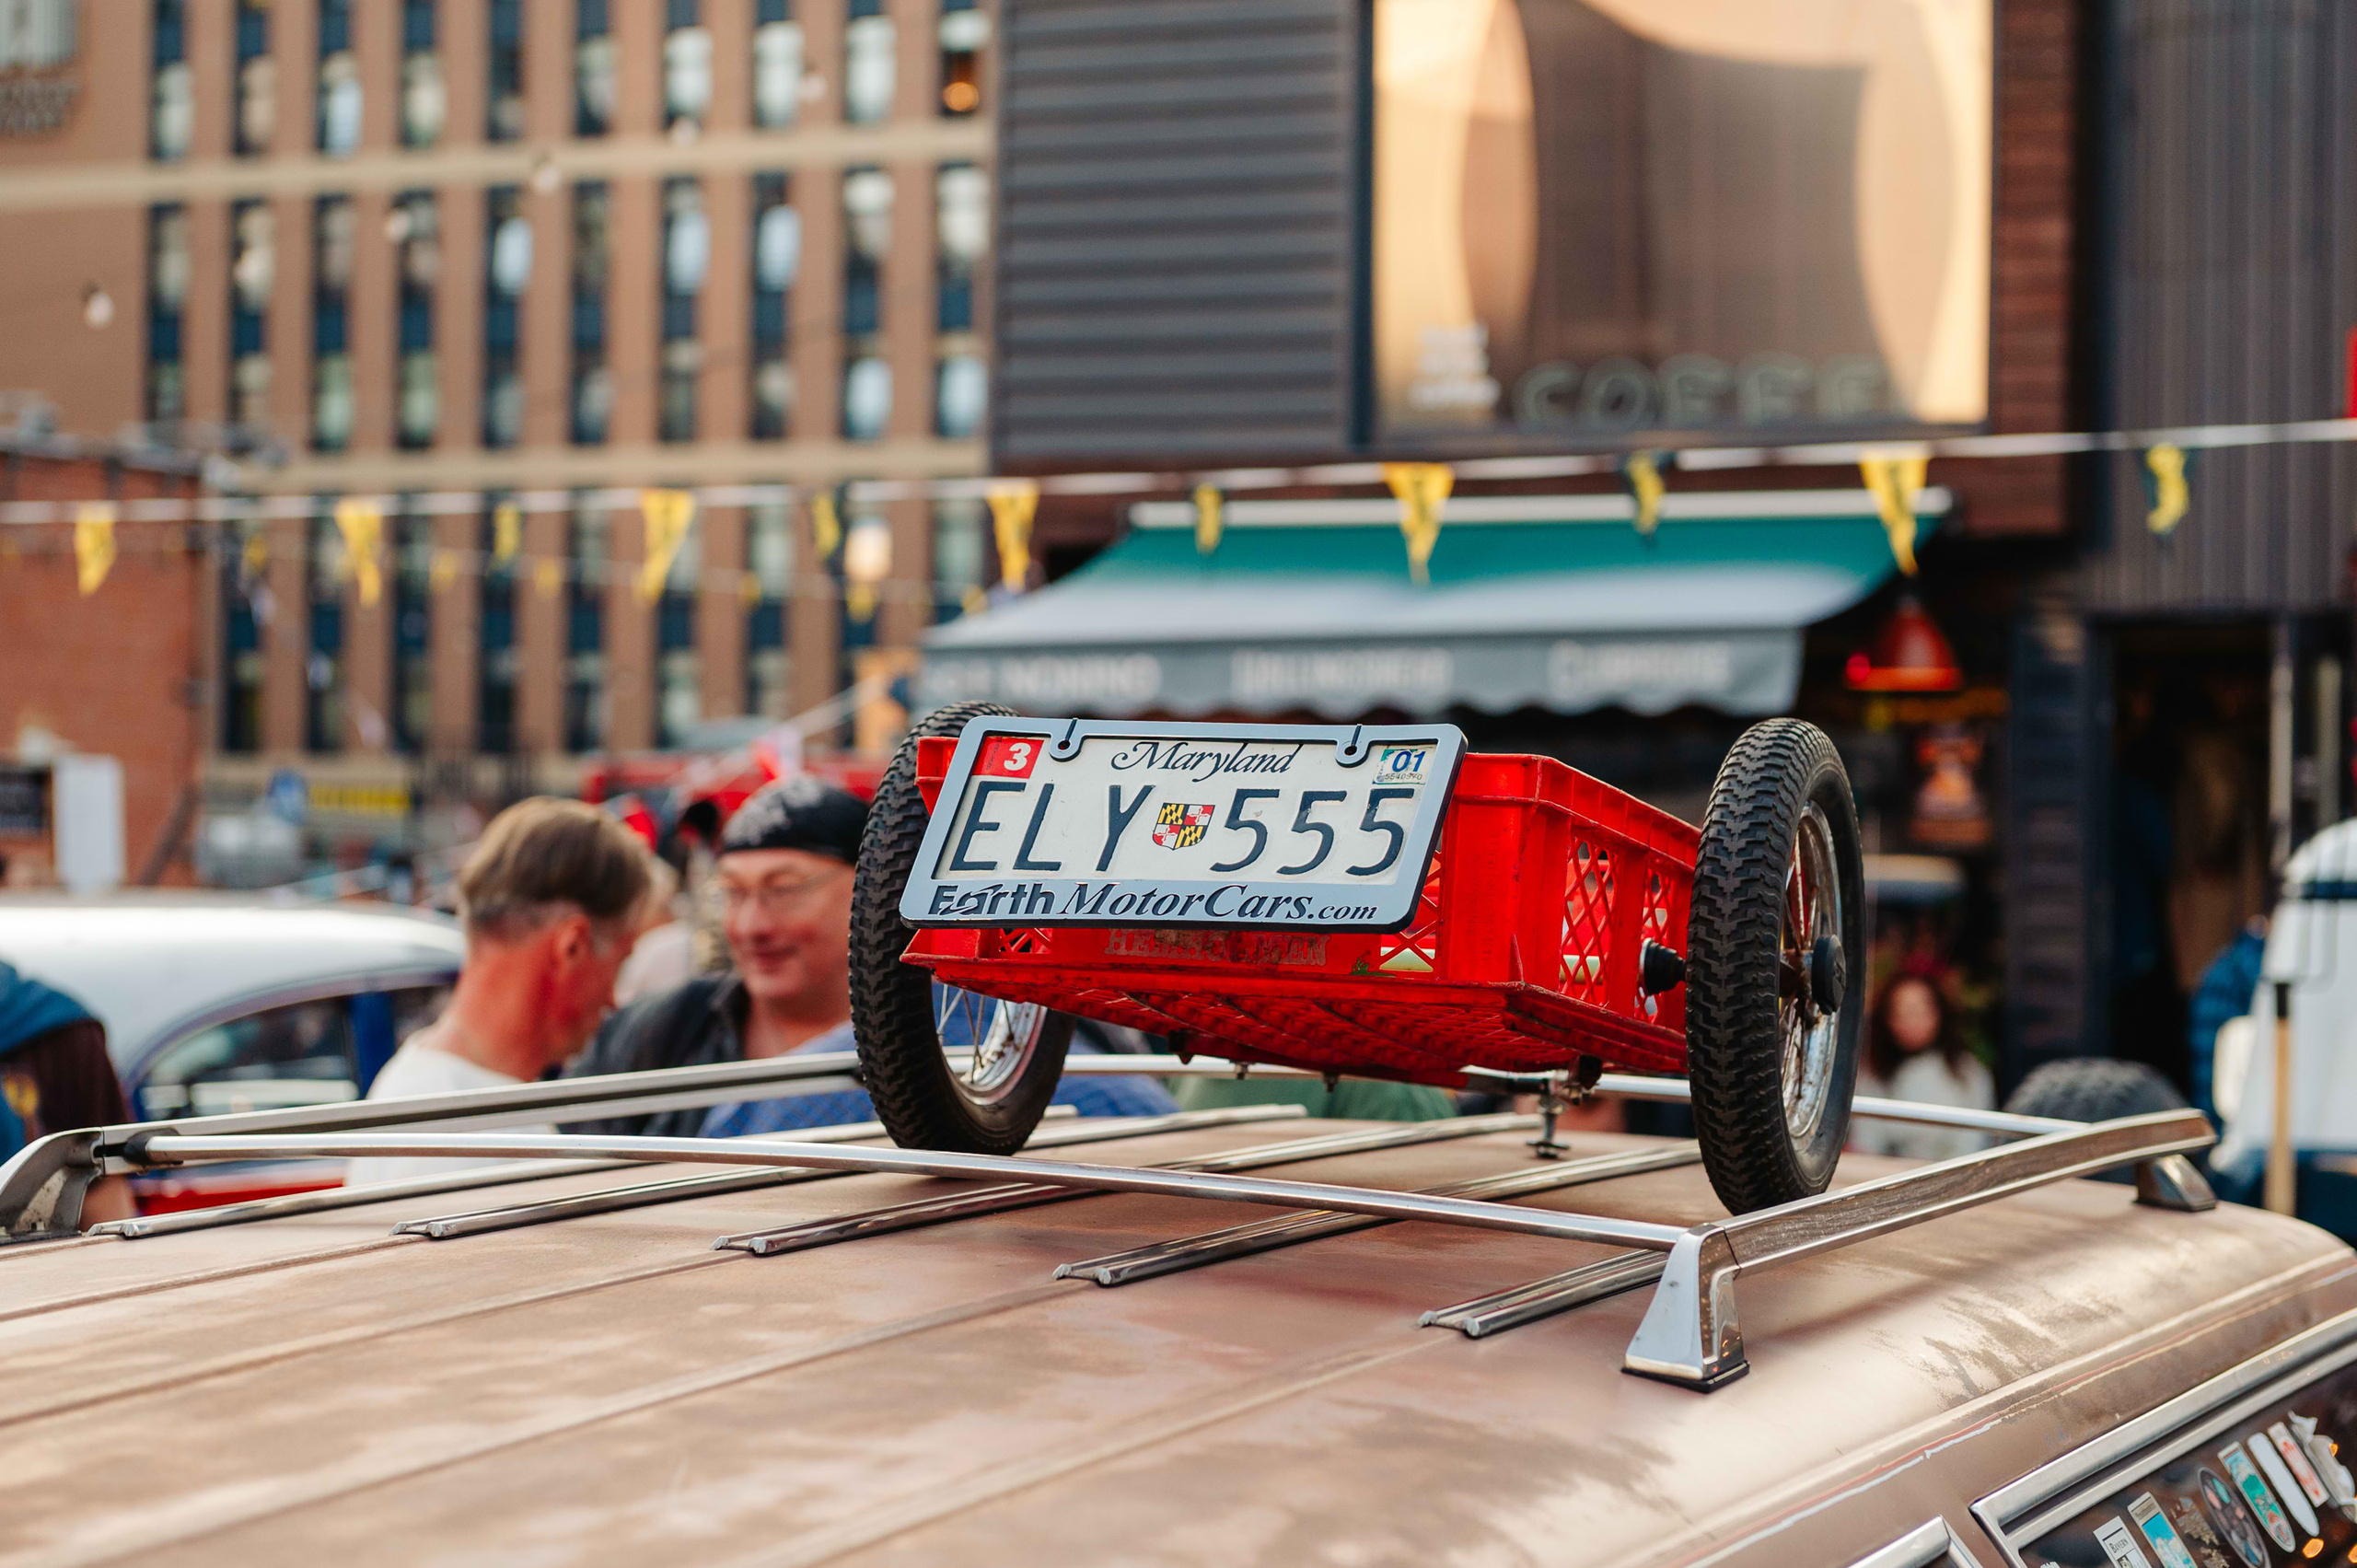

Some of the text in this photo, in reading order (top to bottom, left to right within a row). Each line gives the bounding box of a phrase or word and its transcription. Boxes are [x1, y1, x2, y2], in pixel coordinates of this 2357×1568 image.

[1004, 742, 1031, 771] 3
[1110, 741, 1304, 783] Maryland
[1392, 751, 1426, 772] 01
[949, 781, 1416, 877] ELY 555
[928, 883, 1056, 916] Earth
